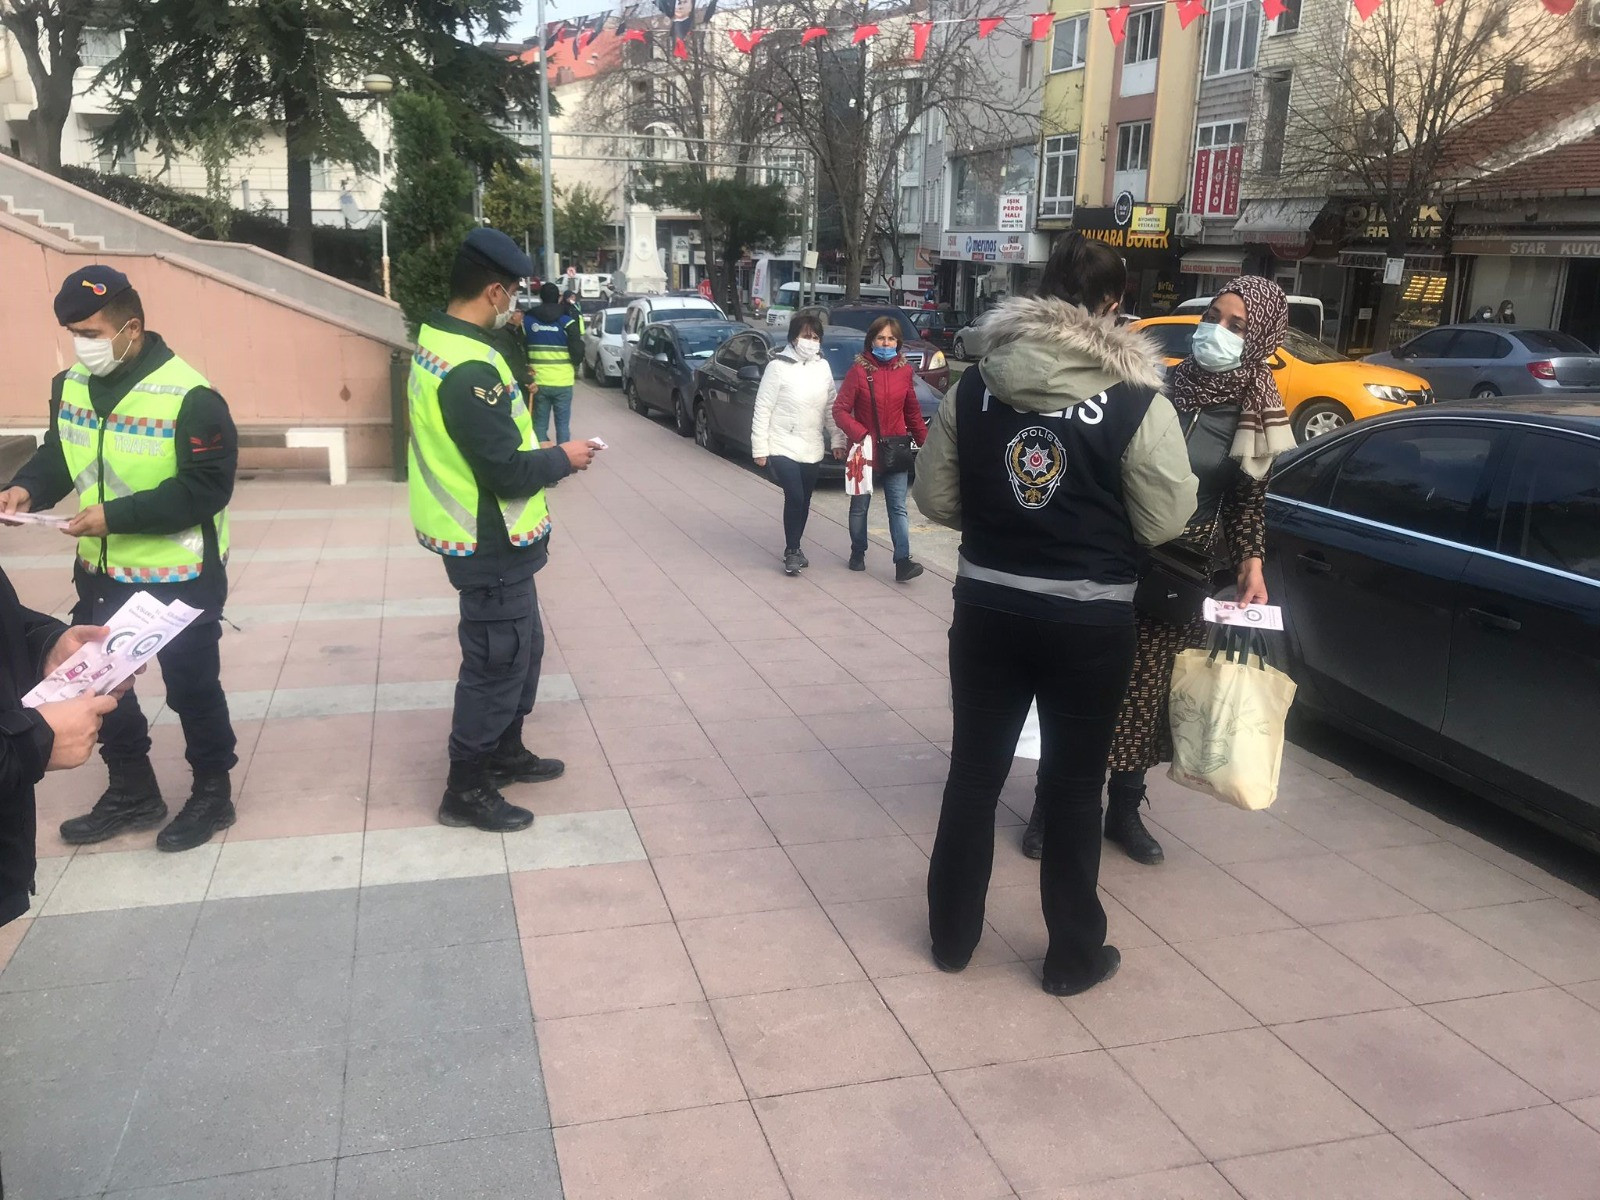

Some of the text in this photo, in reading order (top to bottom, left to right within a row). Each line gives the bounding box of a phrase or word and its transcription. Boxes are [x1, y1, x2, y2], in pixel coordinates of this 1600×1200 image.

[1212, 159, 1222, 206] FOTO
[1510, 242, 1547, 254] STAR
[700, 285, 712, 295] DU
